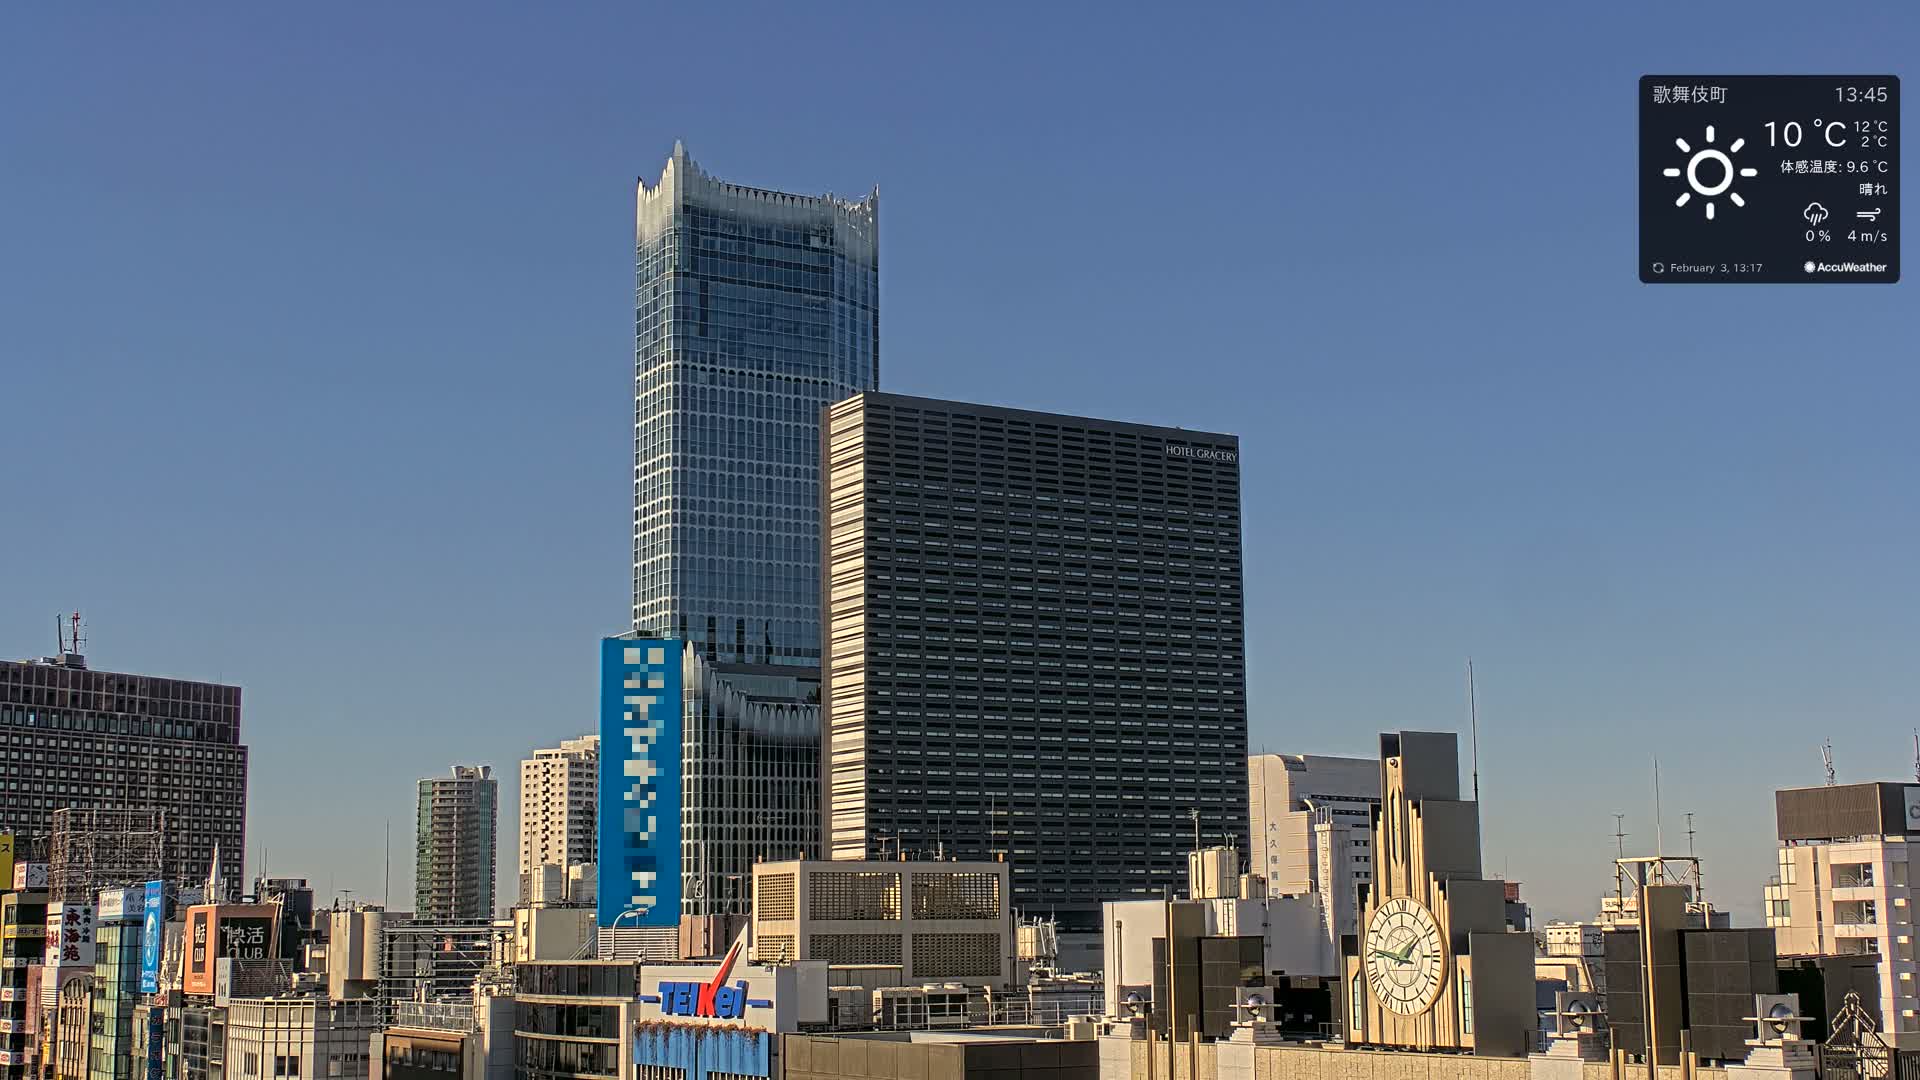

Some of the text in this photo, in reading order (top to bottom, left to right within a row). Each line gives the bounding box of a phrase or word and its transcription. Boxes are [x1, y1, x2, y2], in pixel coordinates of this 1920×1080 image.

[1166, 445, 1237, 462] HOTEL GRACERY
[63, 907, 81, 961] 東海苑
[229, 926, 264, 944] 快活
